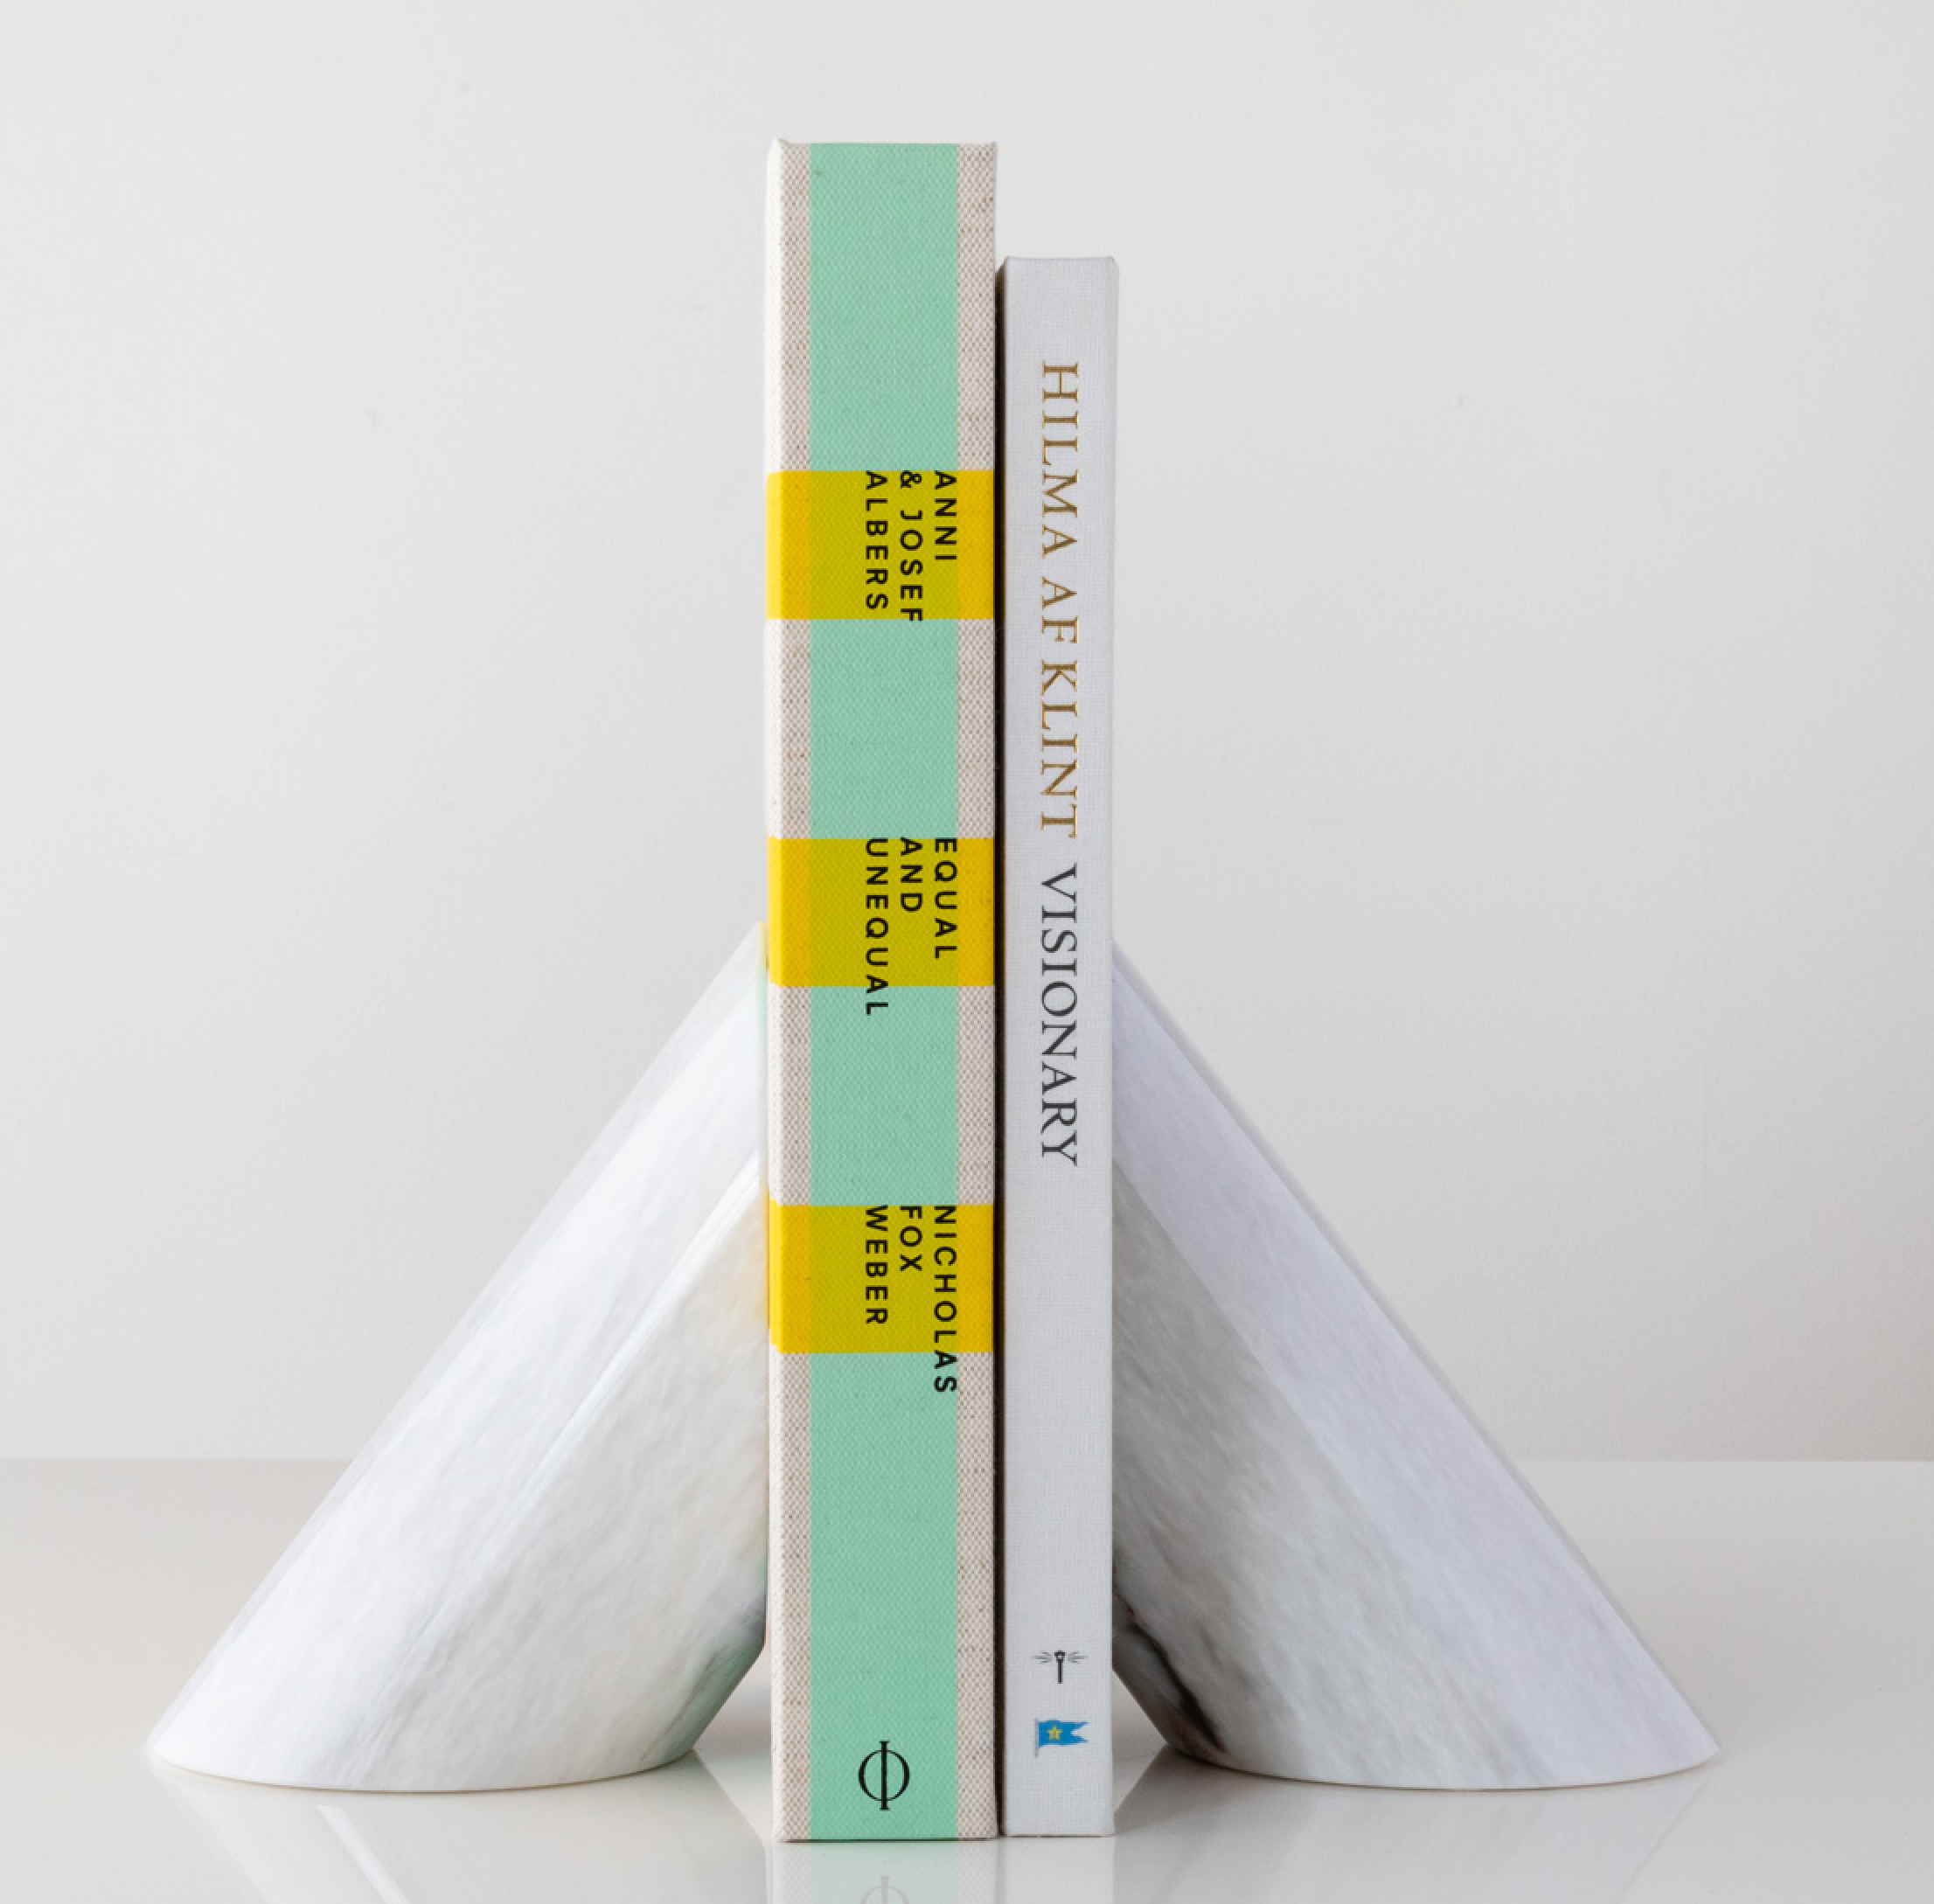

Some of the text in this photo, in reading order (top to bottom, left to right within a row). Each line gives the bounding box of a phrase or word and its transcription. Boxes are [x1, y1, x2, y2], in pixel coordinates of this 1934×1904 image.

[865, 469, 889, 609] ALBERS
[900, 469, 924, 622] & JOSEF
[935, 469, 957, 560] ANNI
[1040, 360, 1080, 1167] HILMA AF KLINT VISIONARY
[865, 838, 889, 1015] UNEQUAL
[900, 837, 922, 912] AND
[935, 837, 957, 959] EQUAL
[865, 1204, 889, 1324] WEBER
[900, 1206, 922, 1272] FOX
[933, 1206, 957, 1393] NICHOLAS
